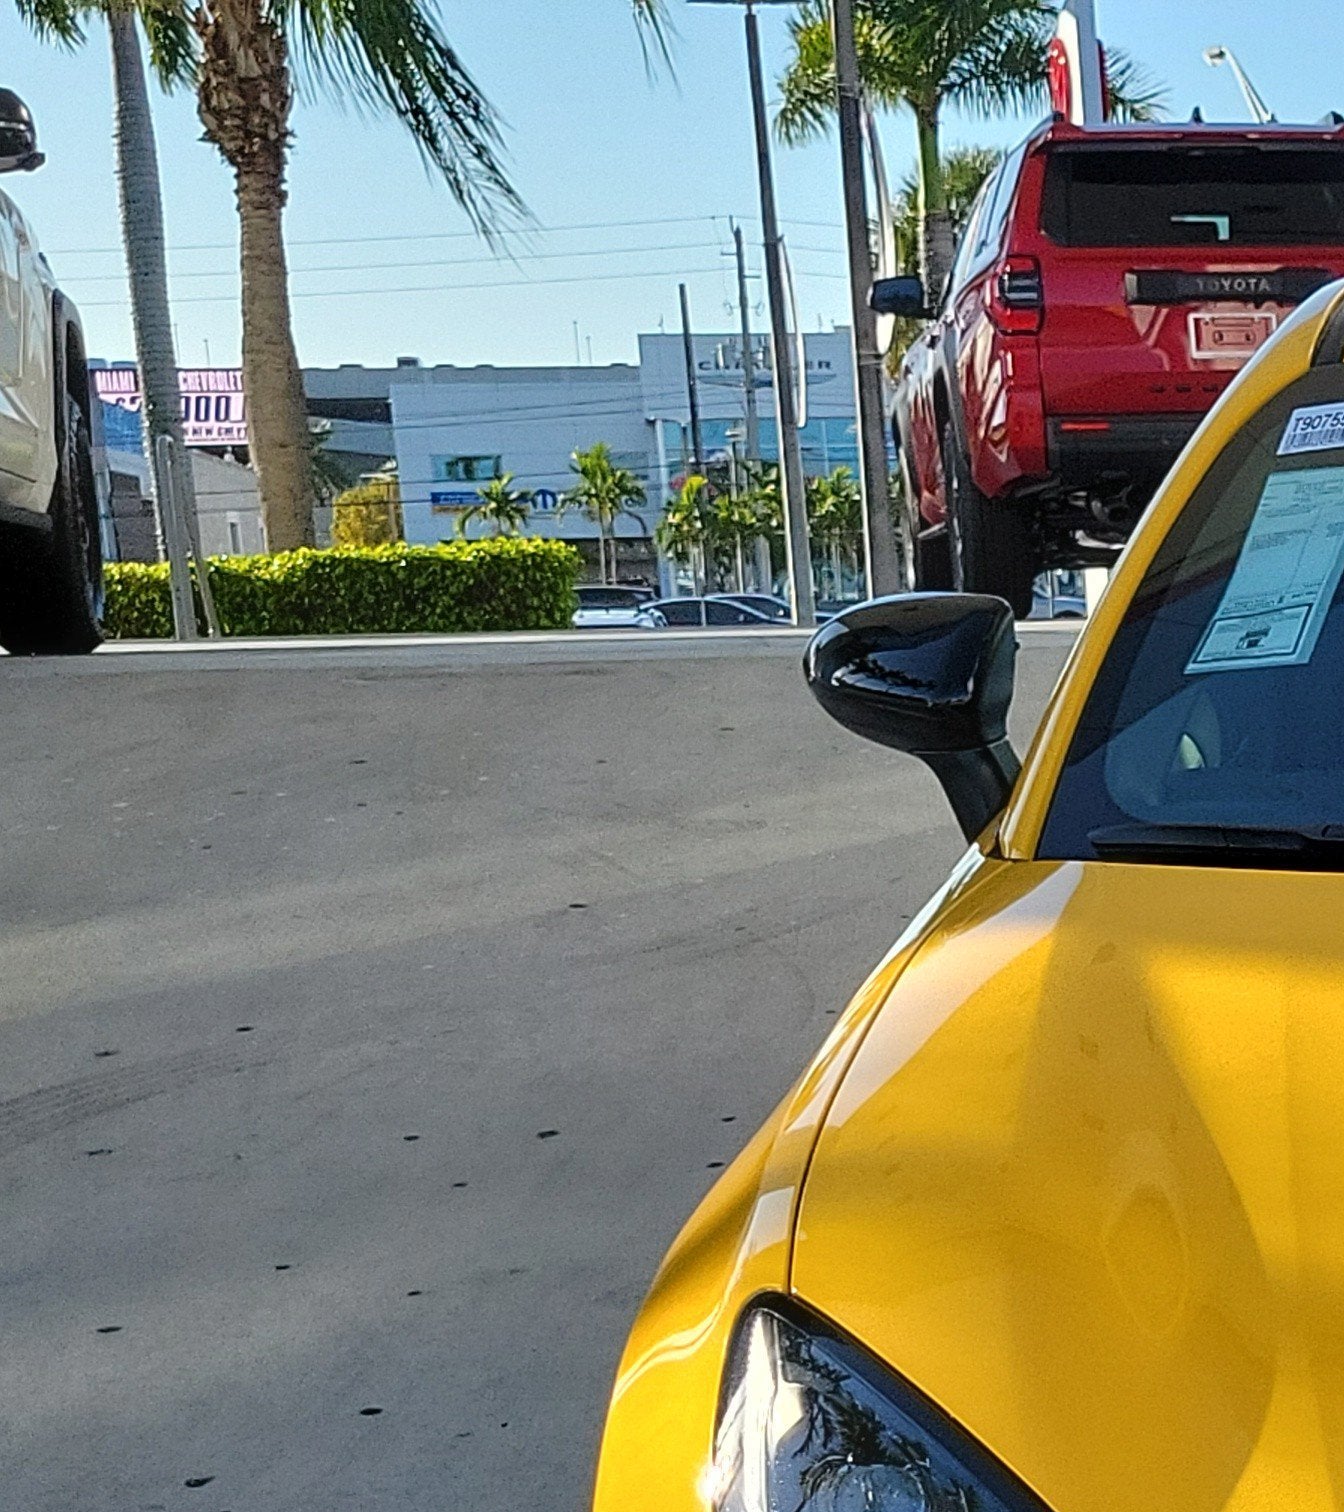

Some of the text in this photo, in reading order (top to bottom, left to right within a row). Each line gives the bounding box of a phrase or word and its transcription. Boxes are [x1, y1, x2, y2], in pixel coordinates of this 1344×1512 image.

[1196, 278, 1271, 291] TOYOTA
[95, 371, 243, 392] MIAMI CHEVROLET
